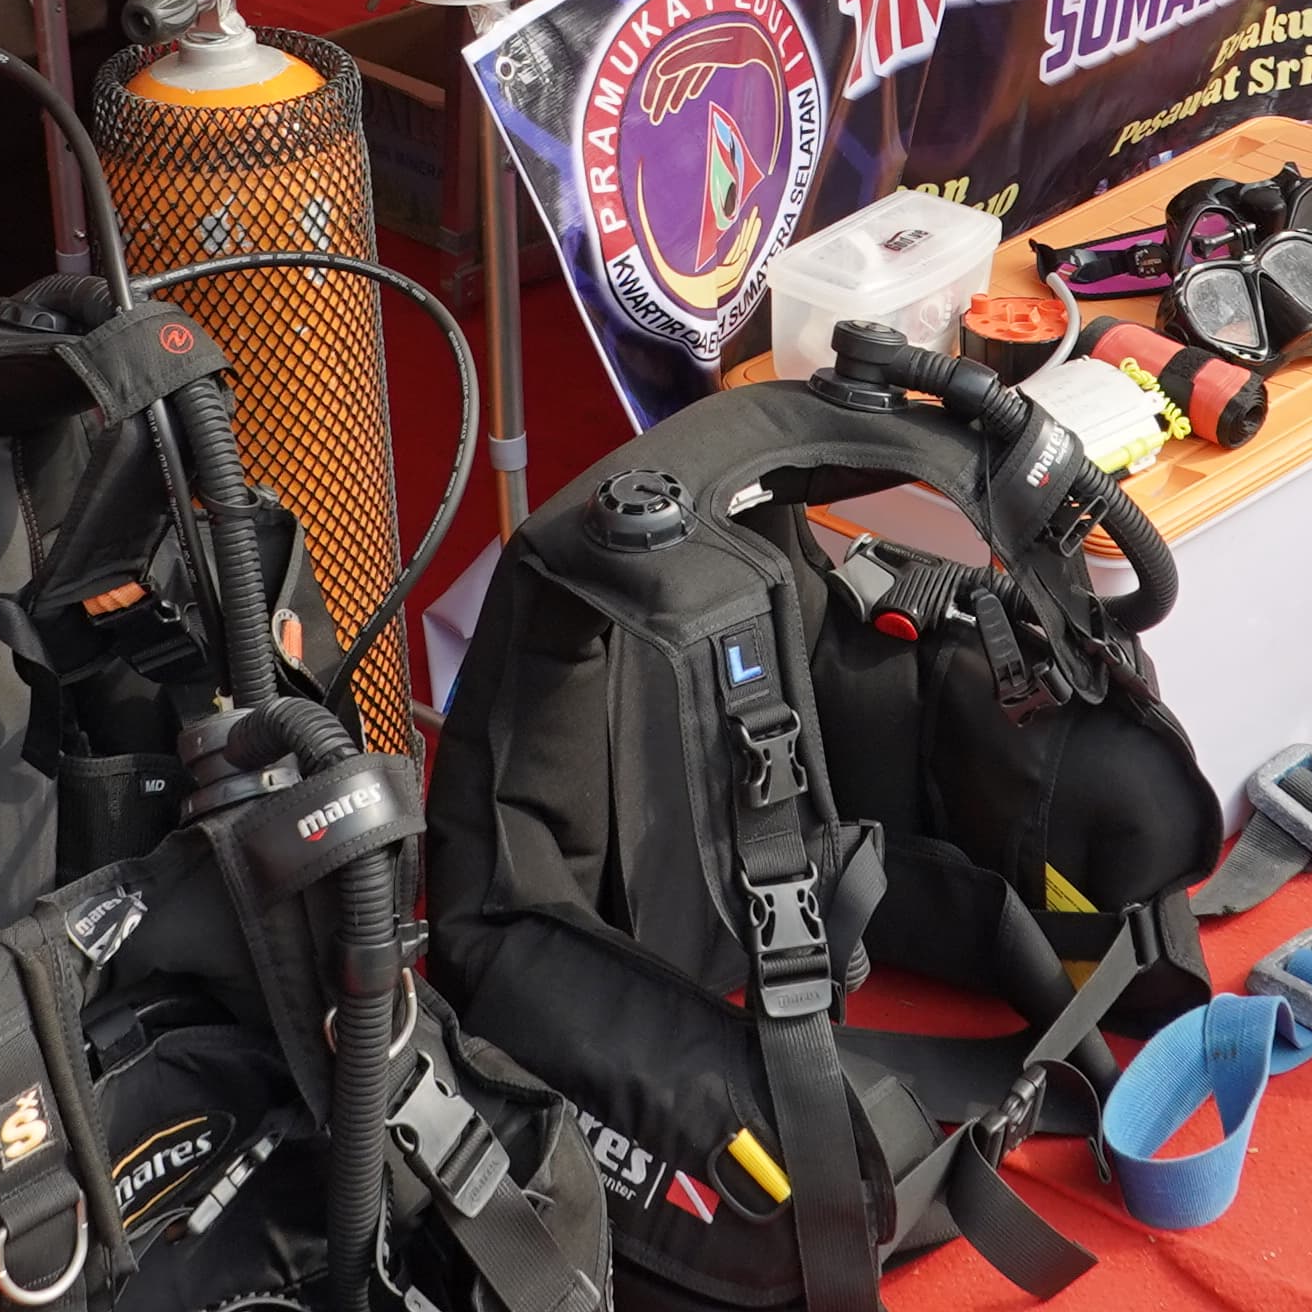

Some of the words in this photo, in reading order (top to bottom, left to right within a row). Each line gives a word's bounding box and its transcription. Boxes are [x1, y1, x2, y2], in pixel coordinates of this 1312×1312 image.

[1108, 68, 1241, 158] Pesawat
[612, 254, 687, 336] KWARTIR
[790, 87, 817, 206] SELATAN
[727, 643, 763, 684] L
[144, 779, 166, 793] MD
[296, 781, 382, 839] mares
[579, 1110, 654, 1185] res
